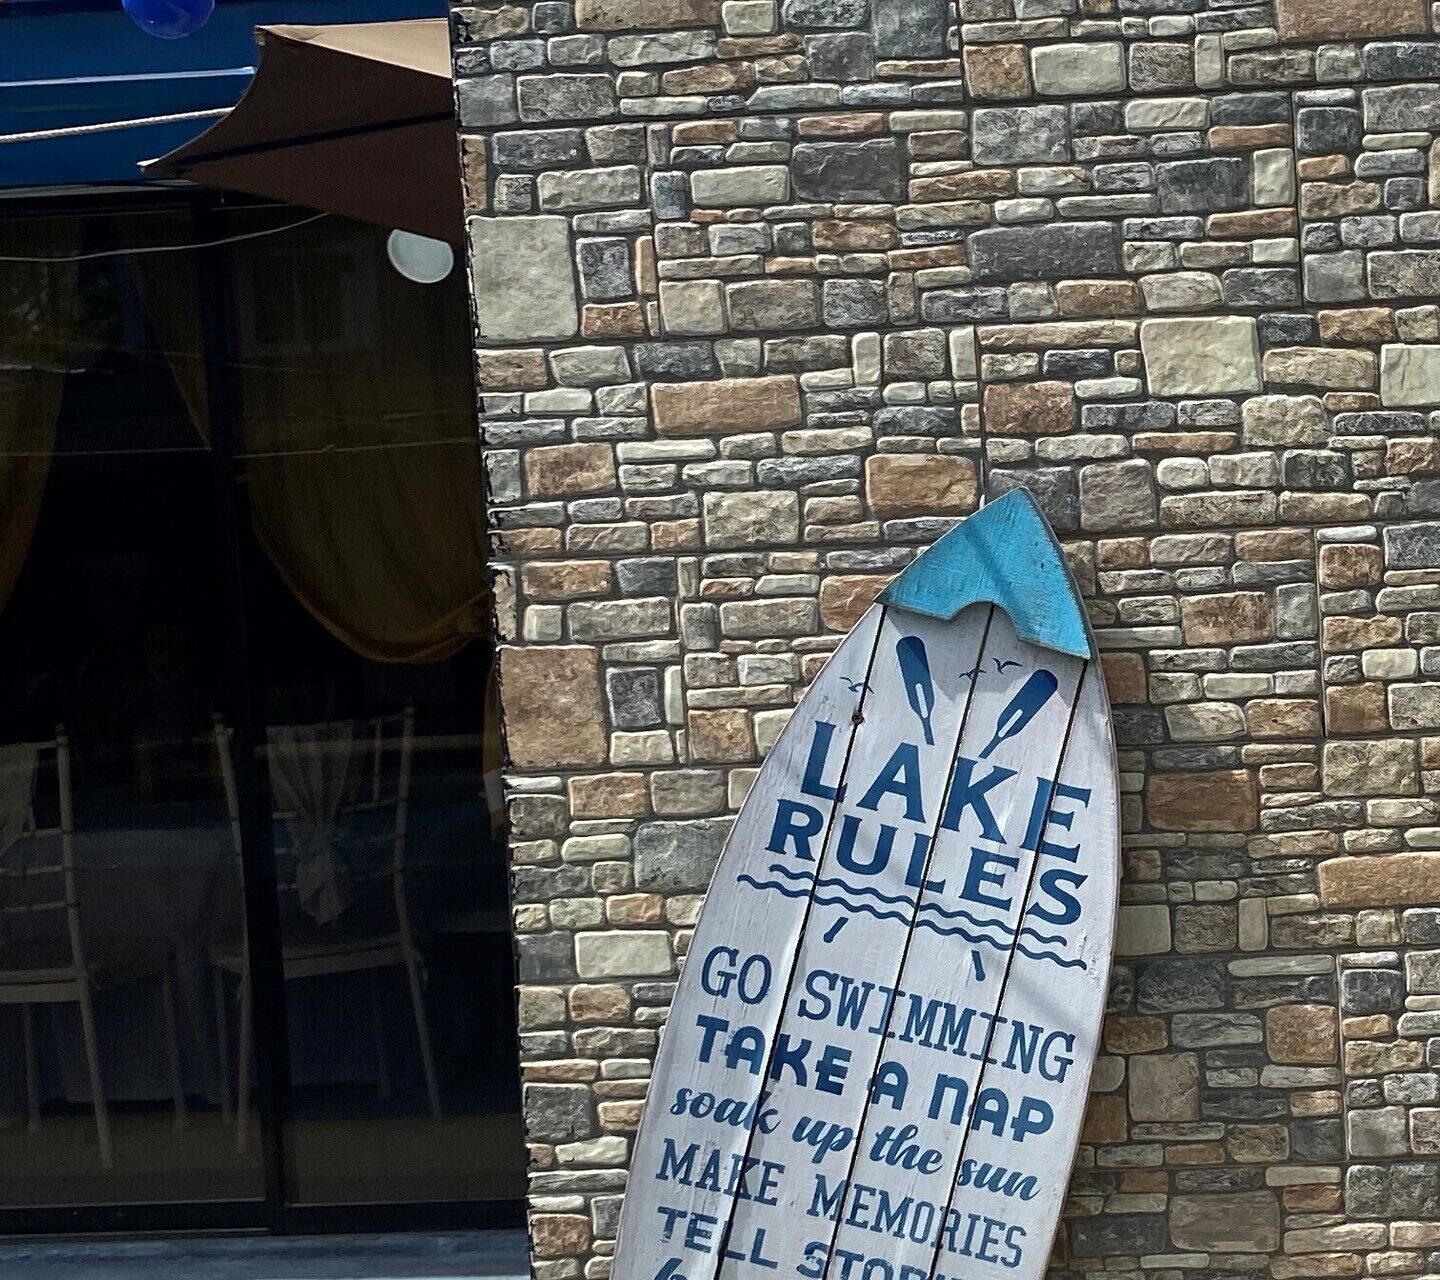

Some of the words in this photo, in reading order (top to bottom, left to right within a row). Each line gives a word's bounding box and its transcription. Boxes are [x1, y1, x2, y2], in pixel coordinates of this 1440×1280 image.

[800, 720, 1092, 863] LAKE
[765, 798, 1088, 925] RULES
[696, 1014, 852, 1095] TAKE
[871, 1061, 909, 1110] A
[701, 945, 772, 1005] GO
[798, 969, 1076, 1083] SWIMMING
[655, 1138, 785, 1206] MAKE
[807, 1173, 1027, 1268] MEMORIES
[670, 1087, 780, 1134] soak
[791, 1116, 854, 1164] up
[869, 1125, 944, 1174] the
[957, 1158, 1040, 1201] sun
[657, 1206, 778, 1269] TELL
